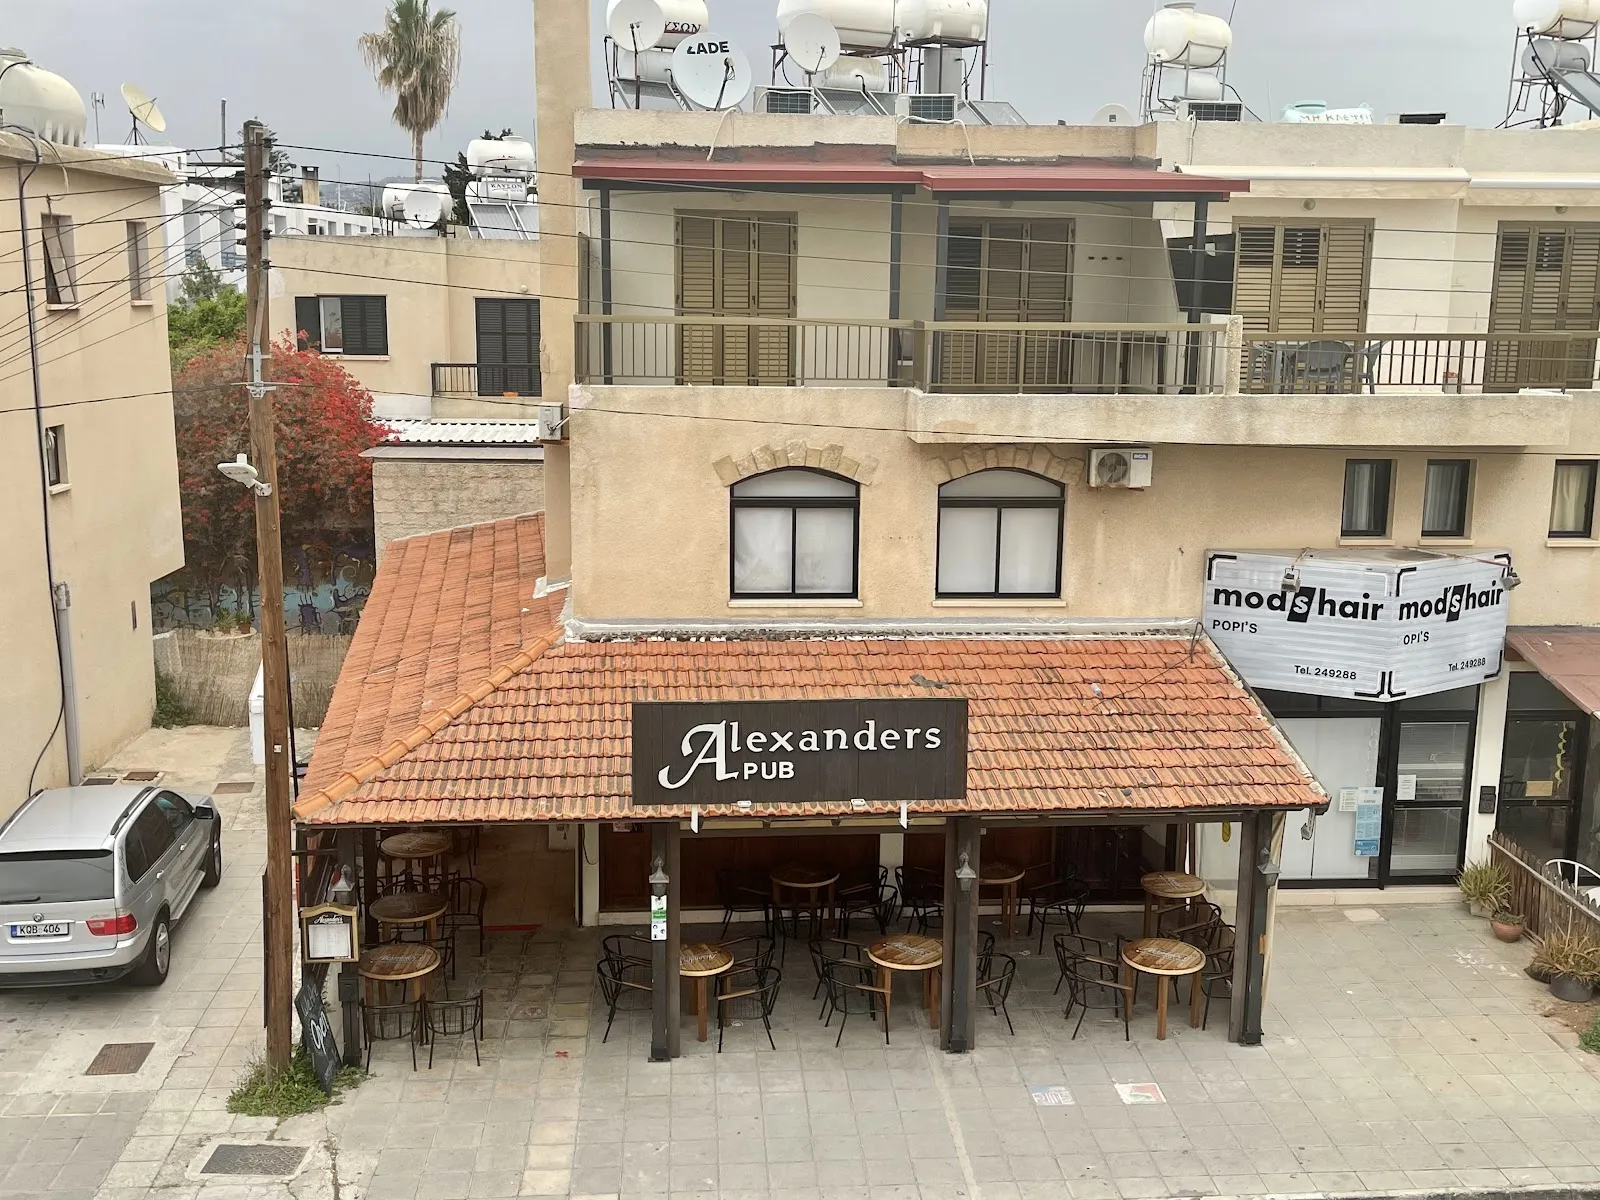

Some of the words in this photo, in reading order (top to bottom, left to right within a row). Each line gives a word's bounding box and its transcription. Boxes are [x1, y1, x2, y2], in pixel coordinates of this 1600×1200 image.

[1212, 619, 1258, 634] POPI'S
[1448, 662, 1459, 672] Tel.
[1460, 657, 1486, 670] 249288
[1294, 665, 1312, 675] Tel.
[1314, 667, 1357, 680] 249288
[657, 719, 942, 789] Alexanders
[743, 761, 795, 780] PUB
[20, 925, 38, 934] KQB
[43, 924, 61, 933] 406
